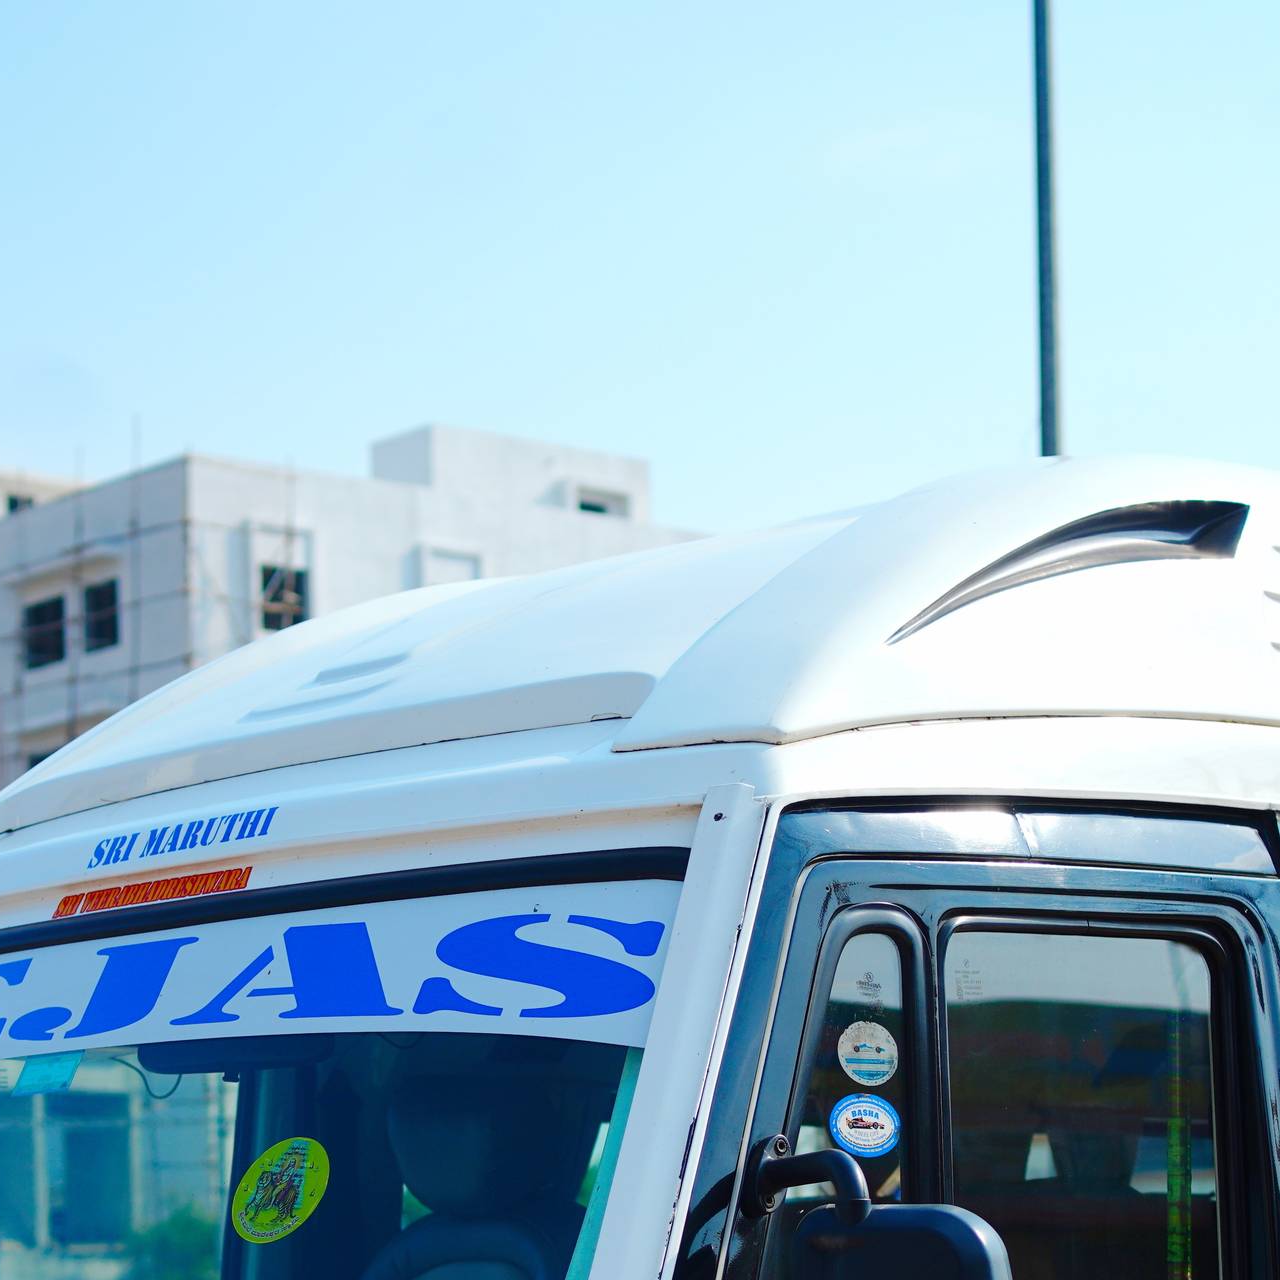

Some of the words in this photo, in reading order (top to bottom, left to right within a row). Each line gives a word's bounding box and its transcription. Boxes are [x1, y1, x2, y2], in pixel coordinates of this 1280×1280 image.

[87, 832, 141, 869] SRI
[139, 807, 279, 859] MARUTHI
[52, 893, 86, 919] SRI
